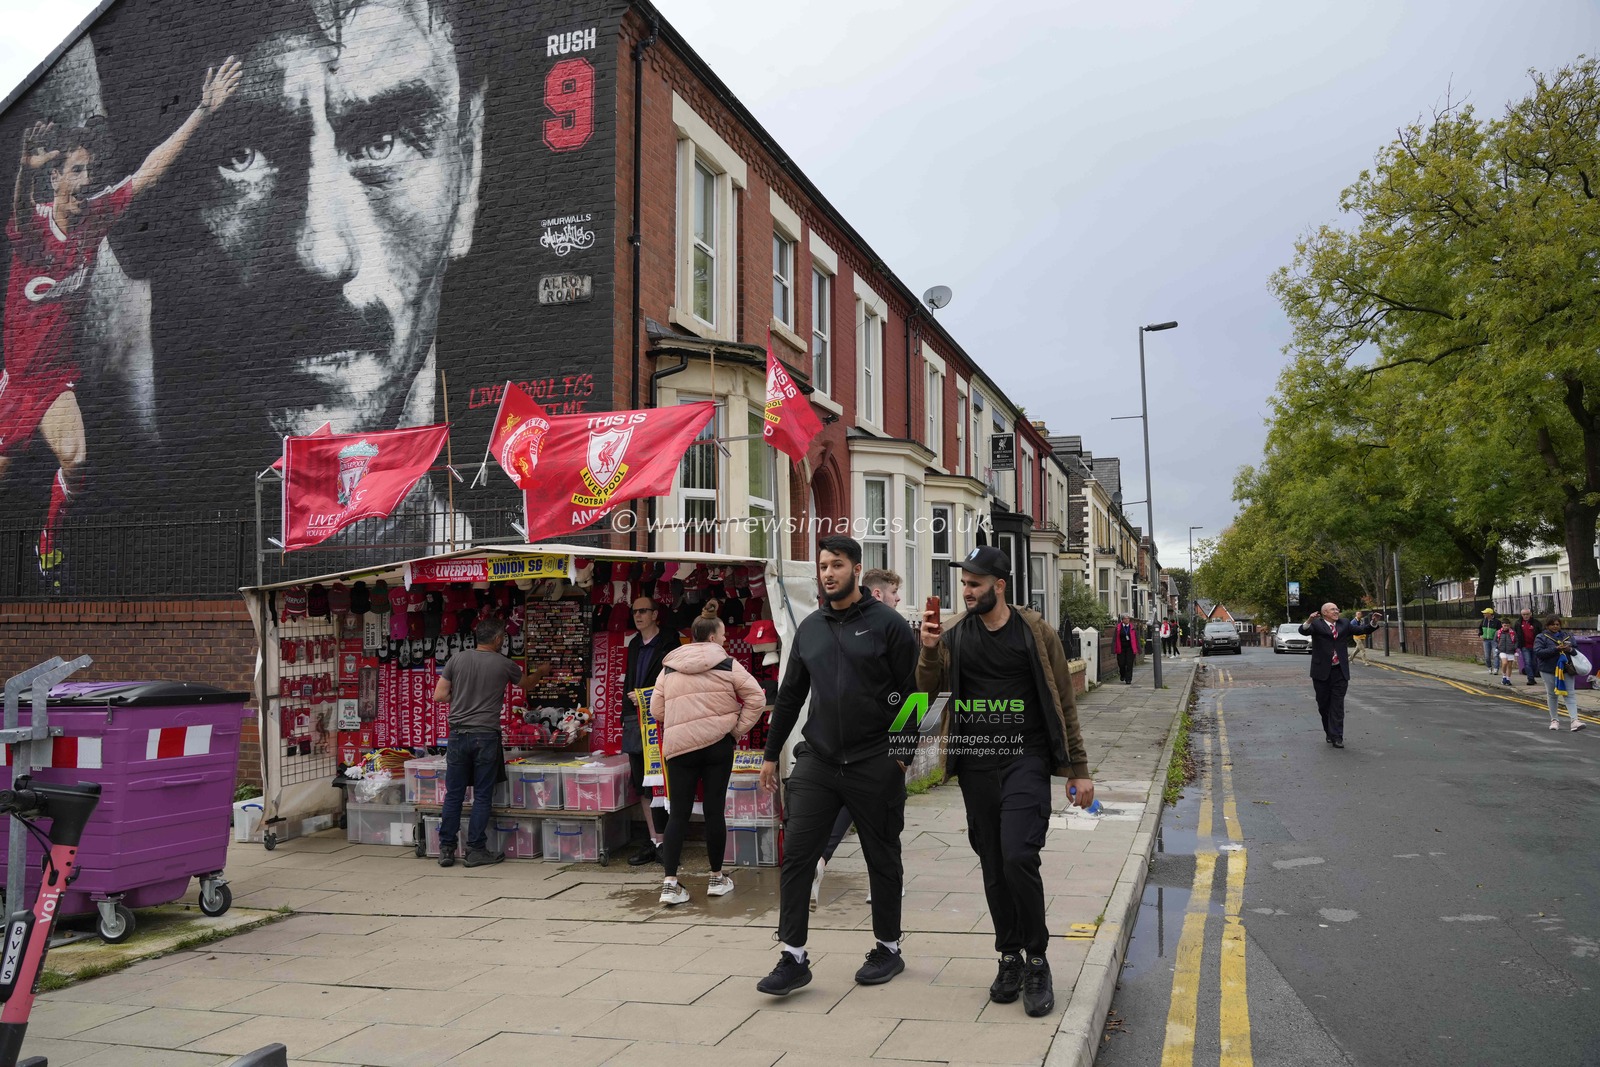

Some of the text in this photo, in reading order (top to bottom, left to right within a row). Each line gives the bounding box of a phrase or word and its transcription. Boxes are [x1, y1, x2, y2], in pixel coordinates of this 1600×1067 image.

[546, 27, 596, 57] RUSH
[542, 57, 595, 153] 9
[541, 213, 591, 227] @MURWALLS
[543, 275, 585, 290] ALROY
[546, 288, 583, 302] ROAD
[784, 383, 797, 399] IS
[587, 413, 647, 429] THIS IS
[583, 471, 625, 497] LIVERPOOL
[435, 563, 484, 577] LIVERPOOL
[493, 561, 525, 575] UNION
[528, 559, 543, 572] SG
[378, 665, 386, 686] TRENT
[424, 658, 432, 746] MO SALAH
[613, 645, 624, 743] LIVERPOOL FC
[402, 669, 411, 747] HARVEY ELLIOTT
[412, 675, 423, 743] CODY GAKPO
[438, 701, 447, 738] LLISTER
[606, 718, 614, 743] ALONE
[647, 728, 660, 745] SG
